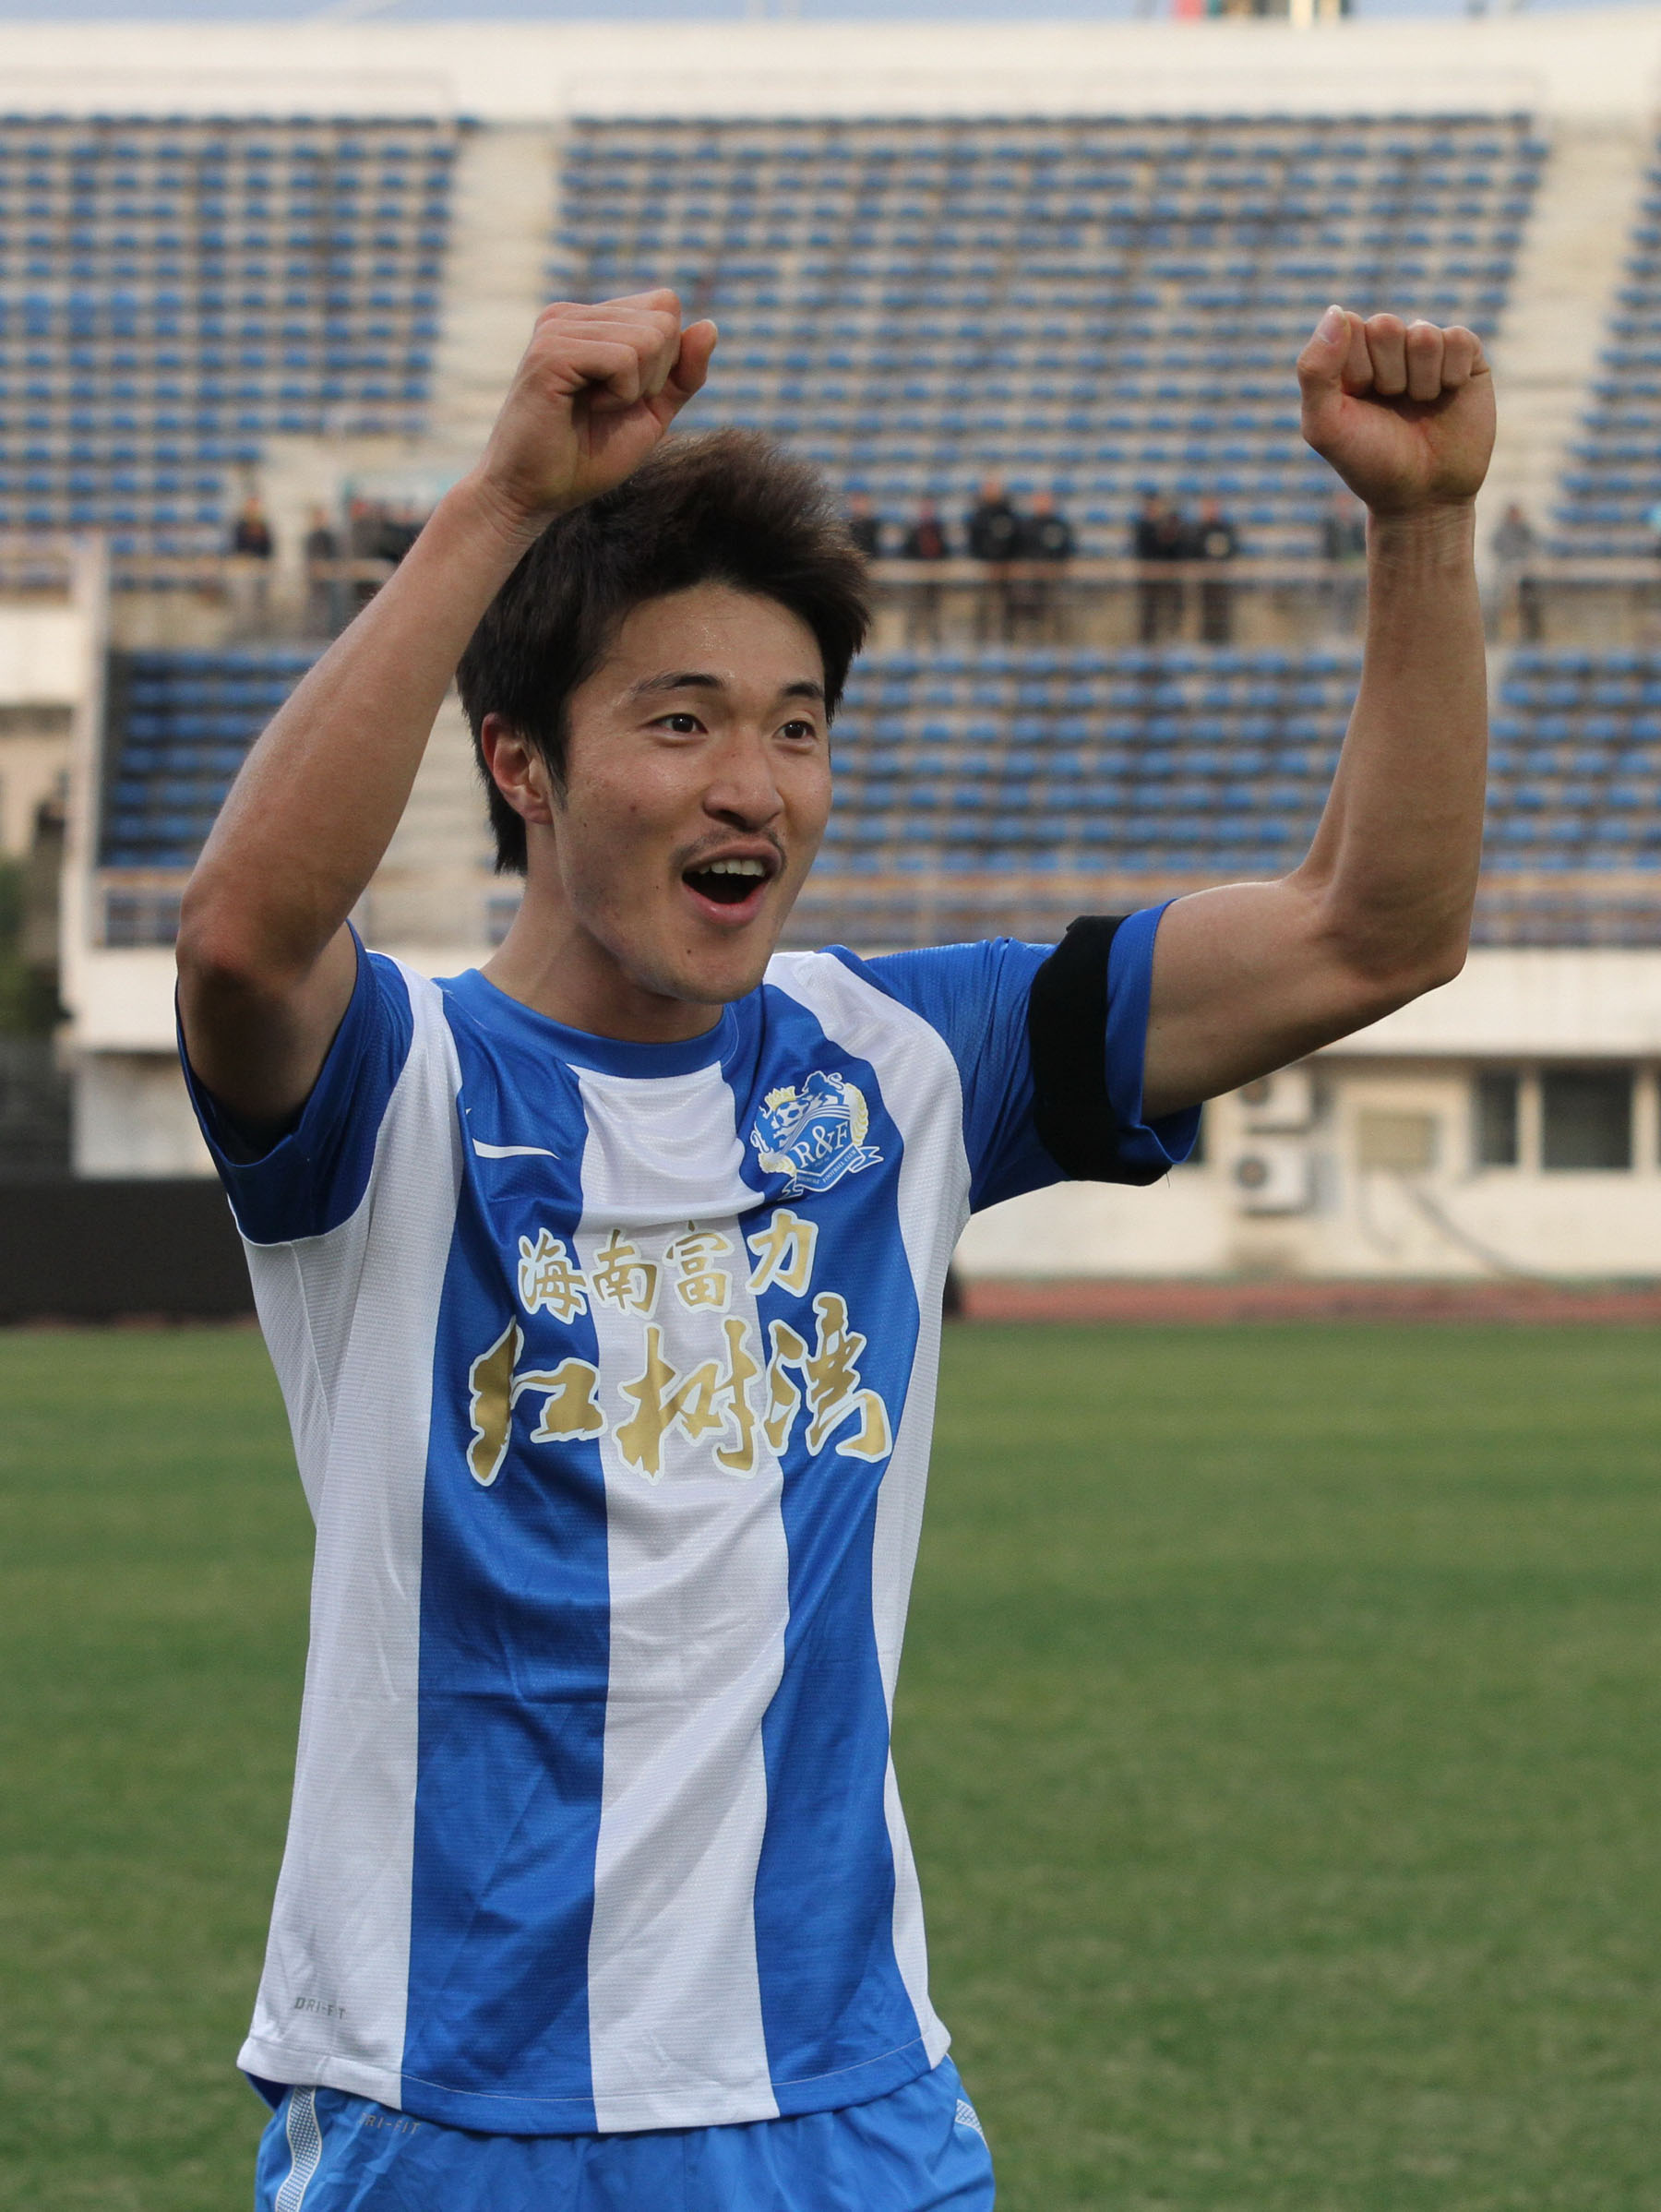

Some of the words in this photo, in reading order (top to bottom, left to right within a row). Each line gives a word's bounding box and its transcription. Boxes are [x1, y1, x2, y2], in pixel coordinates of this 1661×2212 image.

[789, 1120, 849, 1169] R&F
[519, 1208, 819, 1323] 海南富力
[466, 1292, 892, 1487] 红树湾
[294, 1996, 346, 2019] DRI-FT
